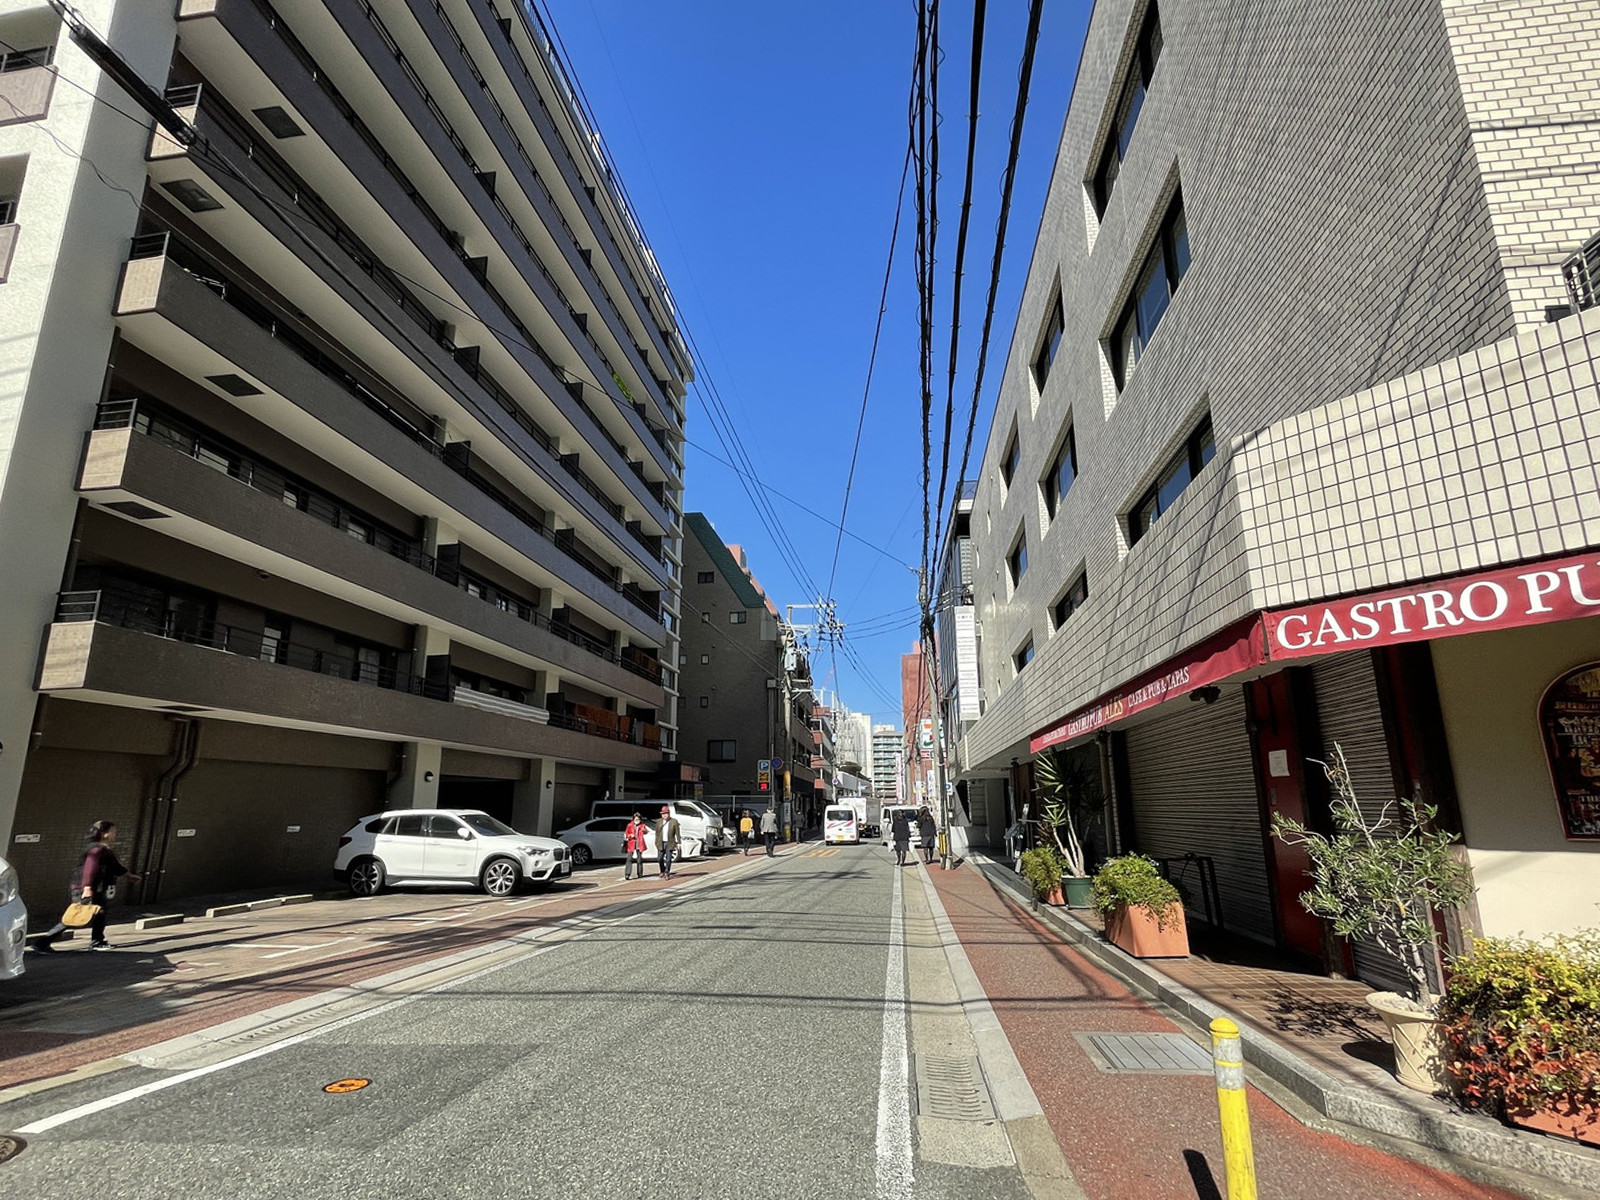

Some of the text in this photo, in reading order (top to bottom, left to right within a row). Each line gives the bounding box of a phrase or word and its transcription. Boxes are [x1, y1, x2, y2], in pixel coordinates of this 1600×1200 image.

[1277, 581, 1508, 650] GASTRO
[1104, 695, 1123, 720] ALES
[1167, 667, 1190, 690] TAPAS
[760, 762, 769, 770] P
